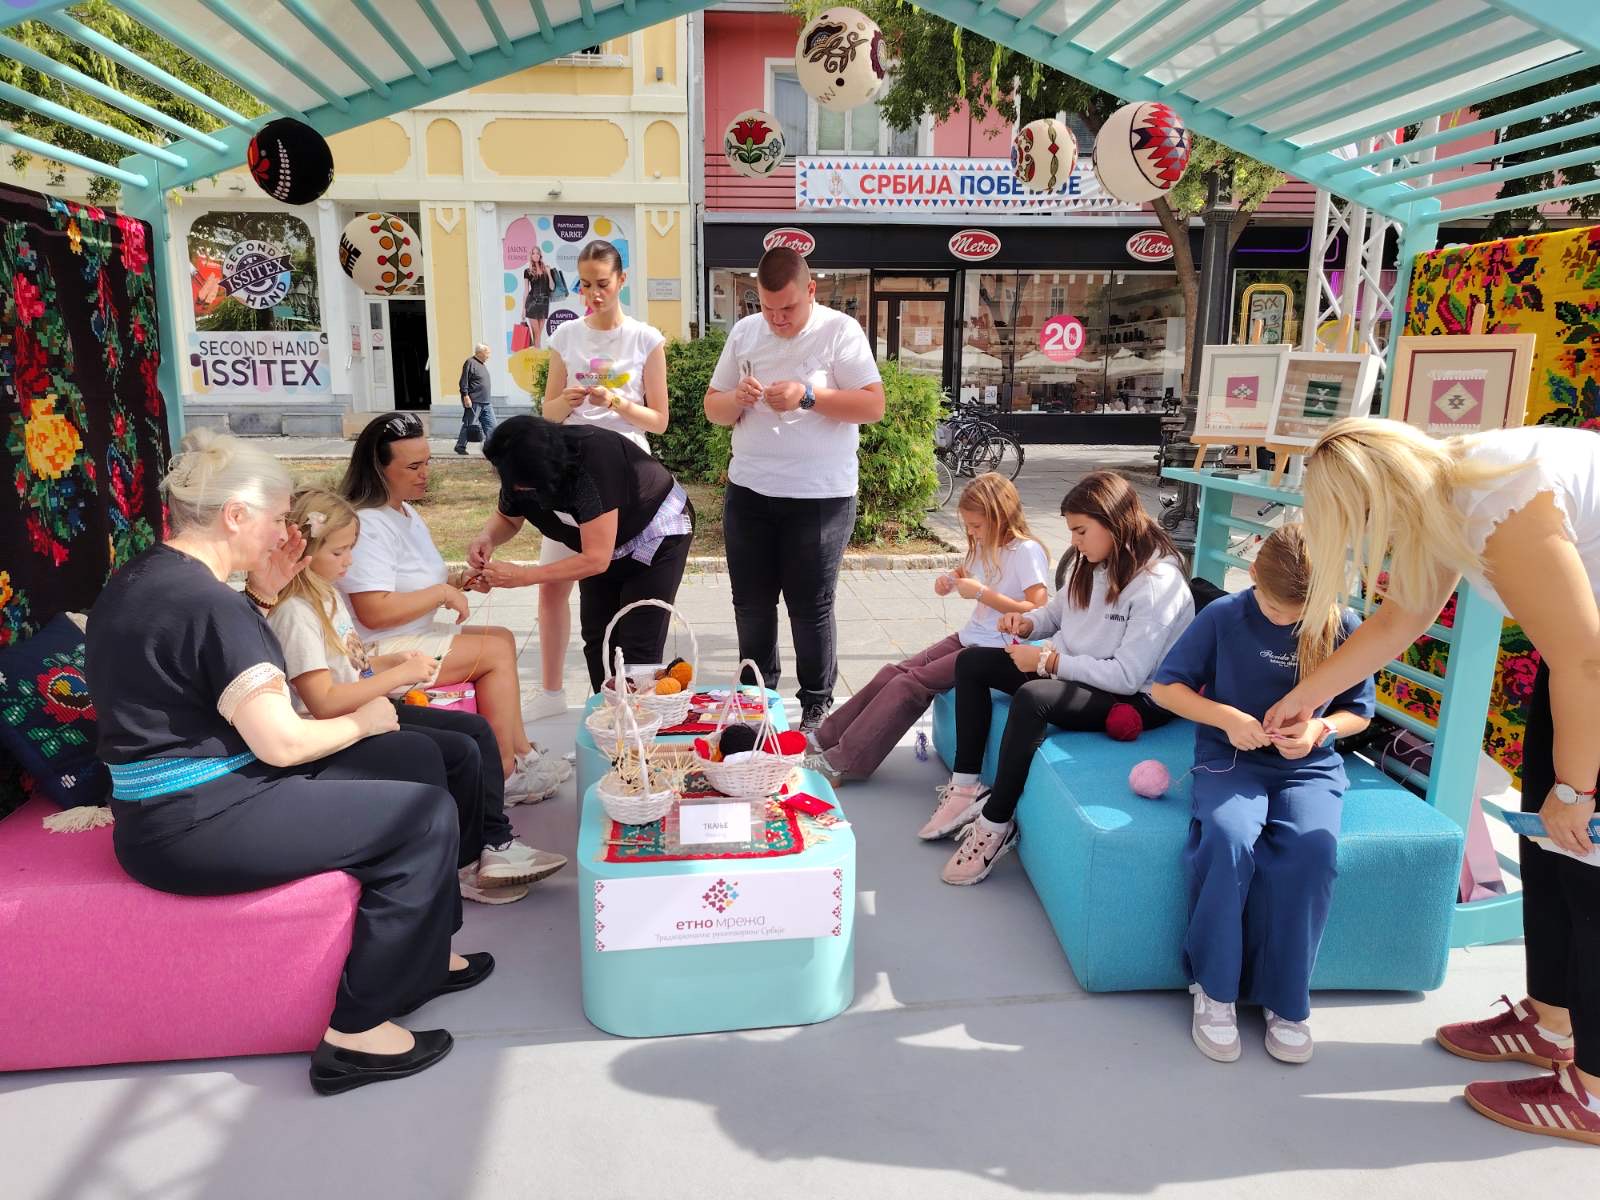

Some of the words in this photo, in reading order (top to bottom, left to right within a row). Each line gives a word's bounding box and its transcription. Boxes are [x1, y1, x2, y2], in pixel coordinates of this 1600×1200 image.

[859, 174, 953, 195] СРБИЈА
[960, 175, 1082, 196] ПОБЕЈЕ
[766, 235, 812, 252] Metro
[952, 236, 998, 253] Metro
[1131, 236, 1174, 254] Metro
[226, 242, 276, 271] SECOND
[226, 257, 288, 292] ISSITEX
[245, 281, 287, 308] HAND
[199, 340, 267, 356] SECOND
[273, 340, 320, 356] HAND
[201, 359, 322, 386] ISSITEX
[716, 915, 766, 930] мрежа
